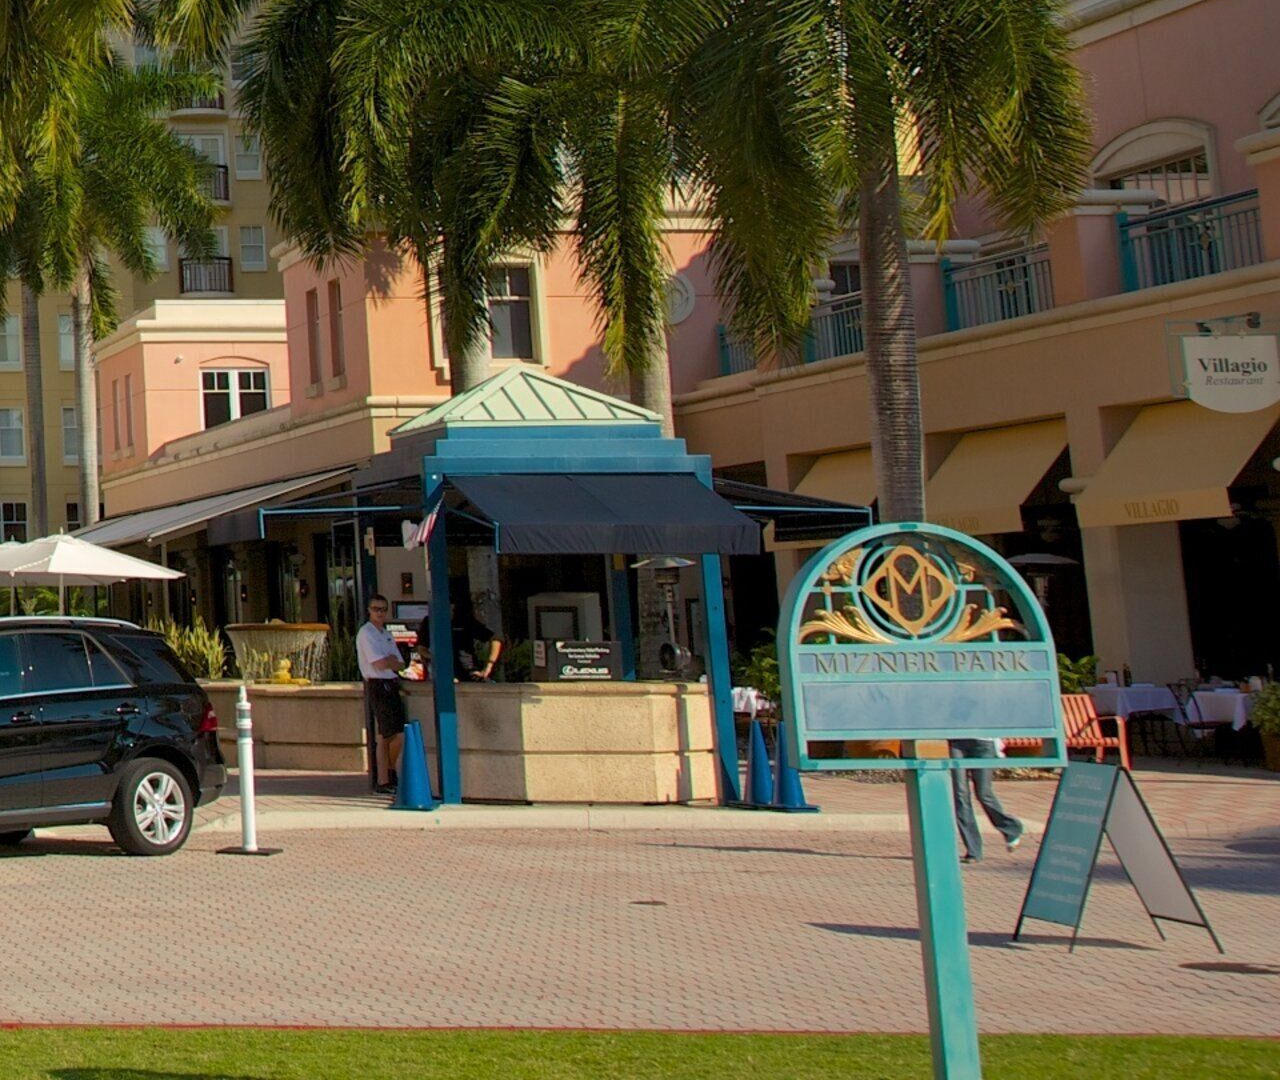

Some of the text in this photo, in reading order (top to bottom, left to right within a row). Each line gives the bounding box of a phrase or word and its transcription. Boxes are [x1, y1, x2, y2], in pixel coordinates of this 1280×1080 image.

[1198, 357, 1268, 377] Villagio
[1205, 376, 1265, 386] Restaurant
[1123, 498, 1180, 519] VILLAGIO
[812, 650, 1030, 674] MIZNER PARK
